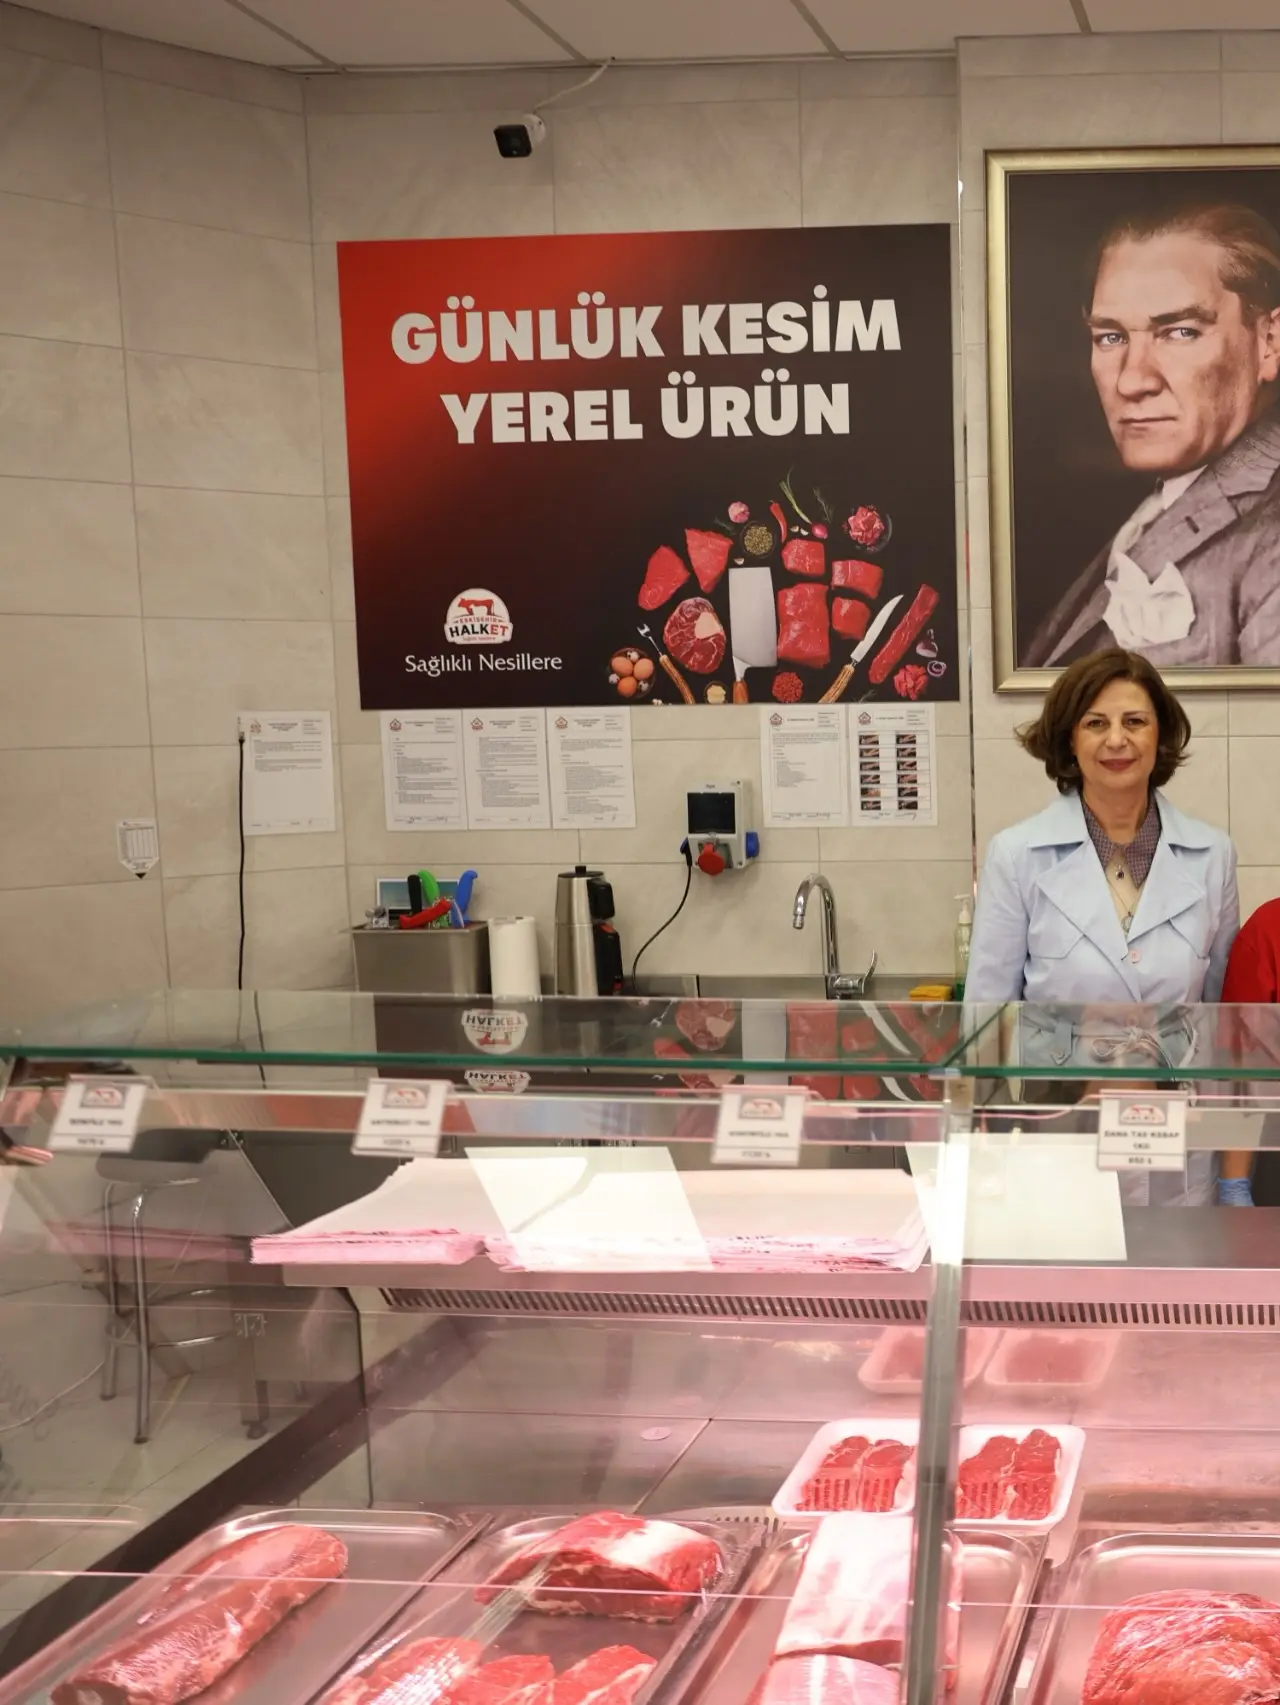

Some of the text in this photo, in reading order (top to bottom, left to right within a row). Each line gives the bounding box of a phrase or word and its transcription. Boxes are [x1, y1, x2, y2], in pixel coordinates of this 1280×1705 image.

[391, 284, 902, 364] GÜNLÜK KESİM
[440, 367, 850, 444] YEREL ÜRÜN
[449, 623, 509, 638] HALKET
[404, 652, 563, 678] Sağlıklı Nesillere
